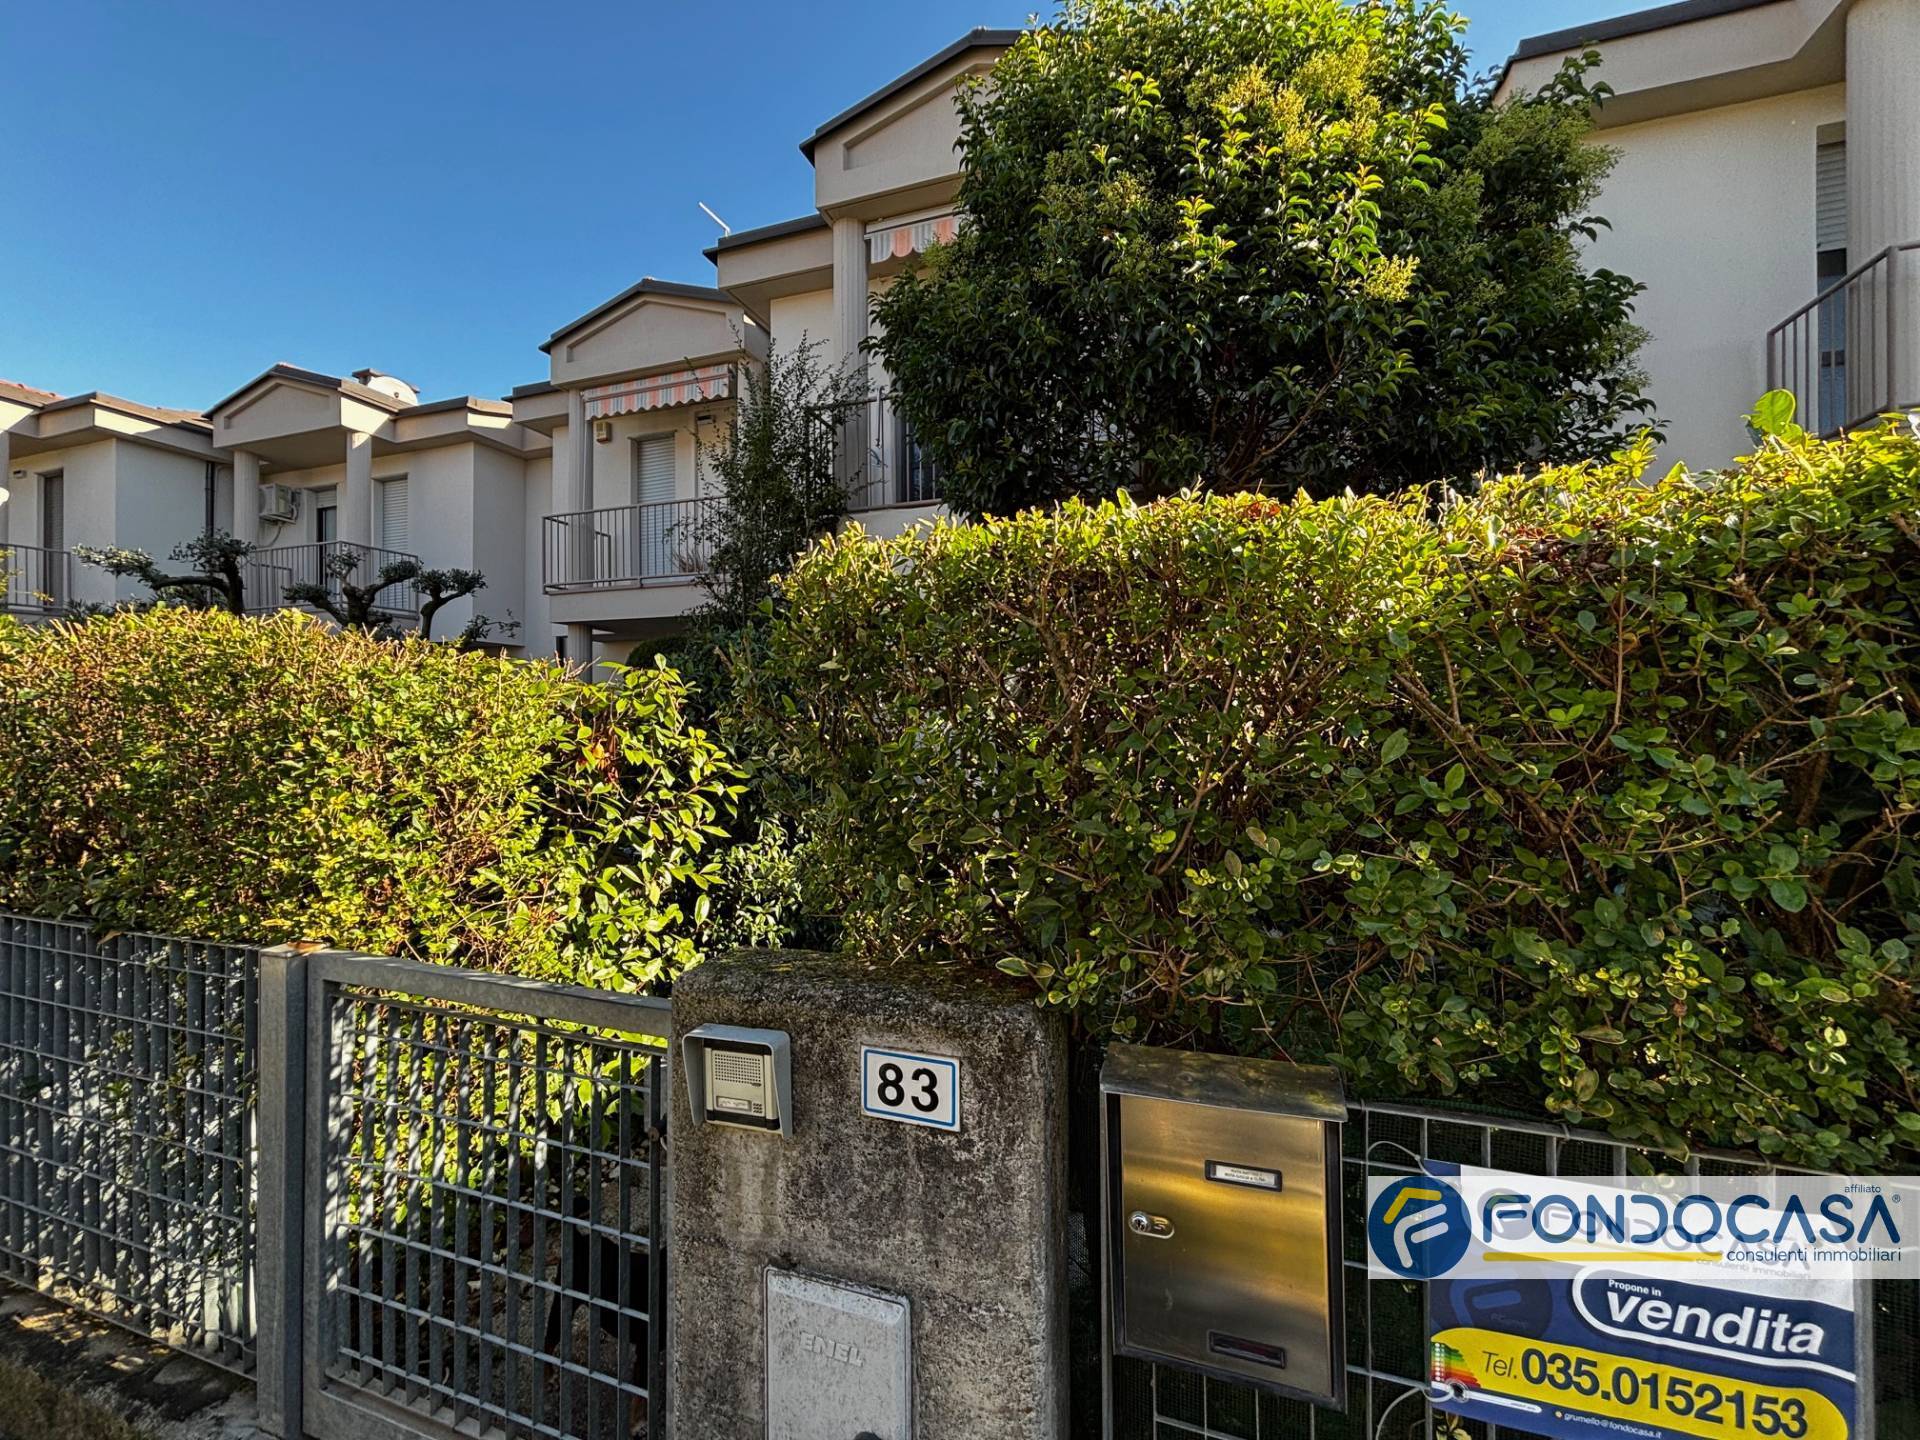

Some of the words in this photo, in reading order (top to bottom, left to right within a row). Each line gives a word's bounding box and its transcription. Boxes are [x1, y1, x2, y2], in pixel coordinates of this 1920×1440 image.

[877, 1062, 940, 1112] 83
[1608, 1279, 1650, 1295] Propone
[1651, 1287, 1662, 1297] in
[1606, 1291, 1825, 1356] vendita
[800, 1331, 864, 1368] ENEL
[1482, 1350, 1518, 1380] Tel.
[1521, 1347, 1808, 1440] 035.0152153
[1564, 1412, 1663, 1440] grumello@fondocasa.it
